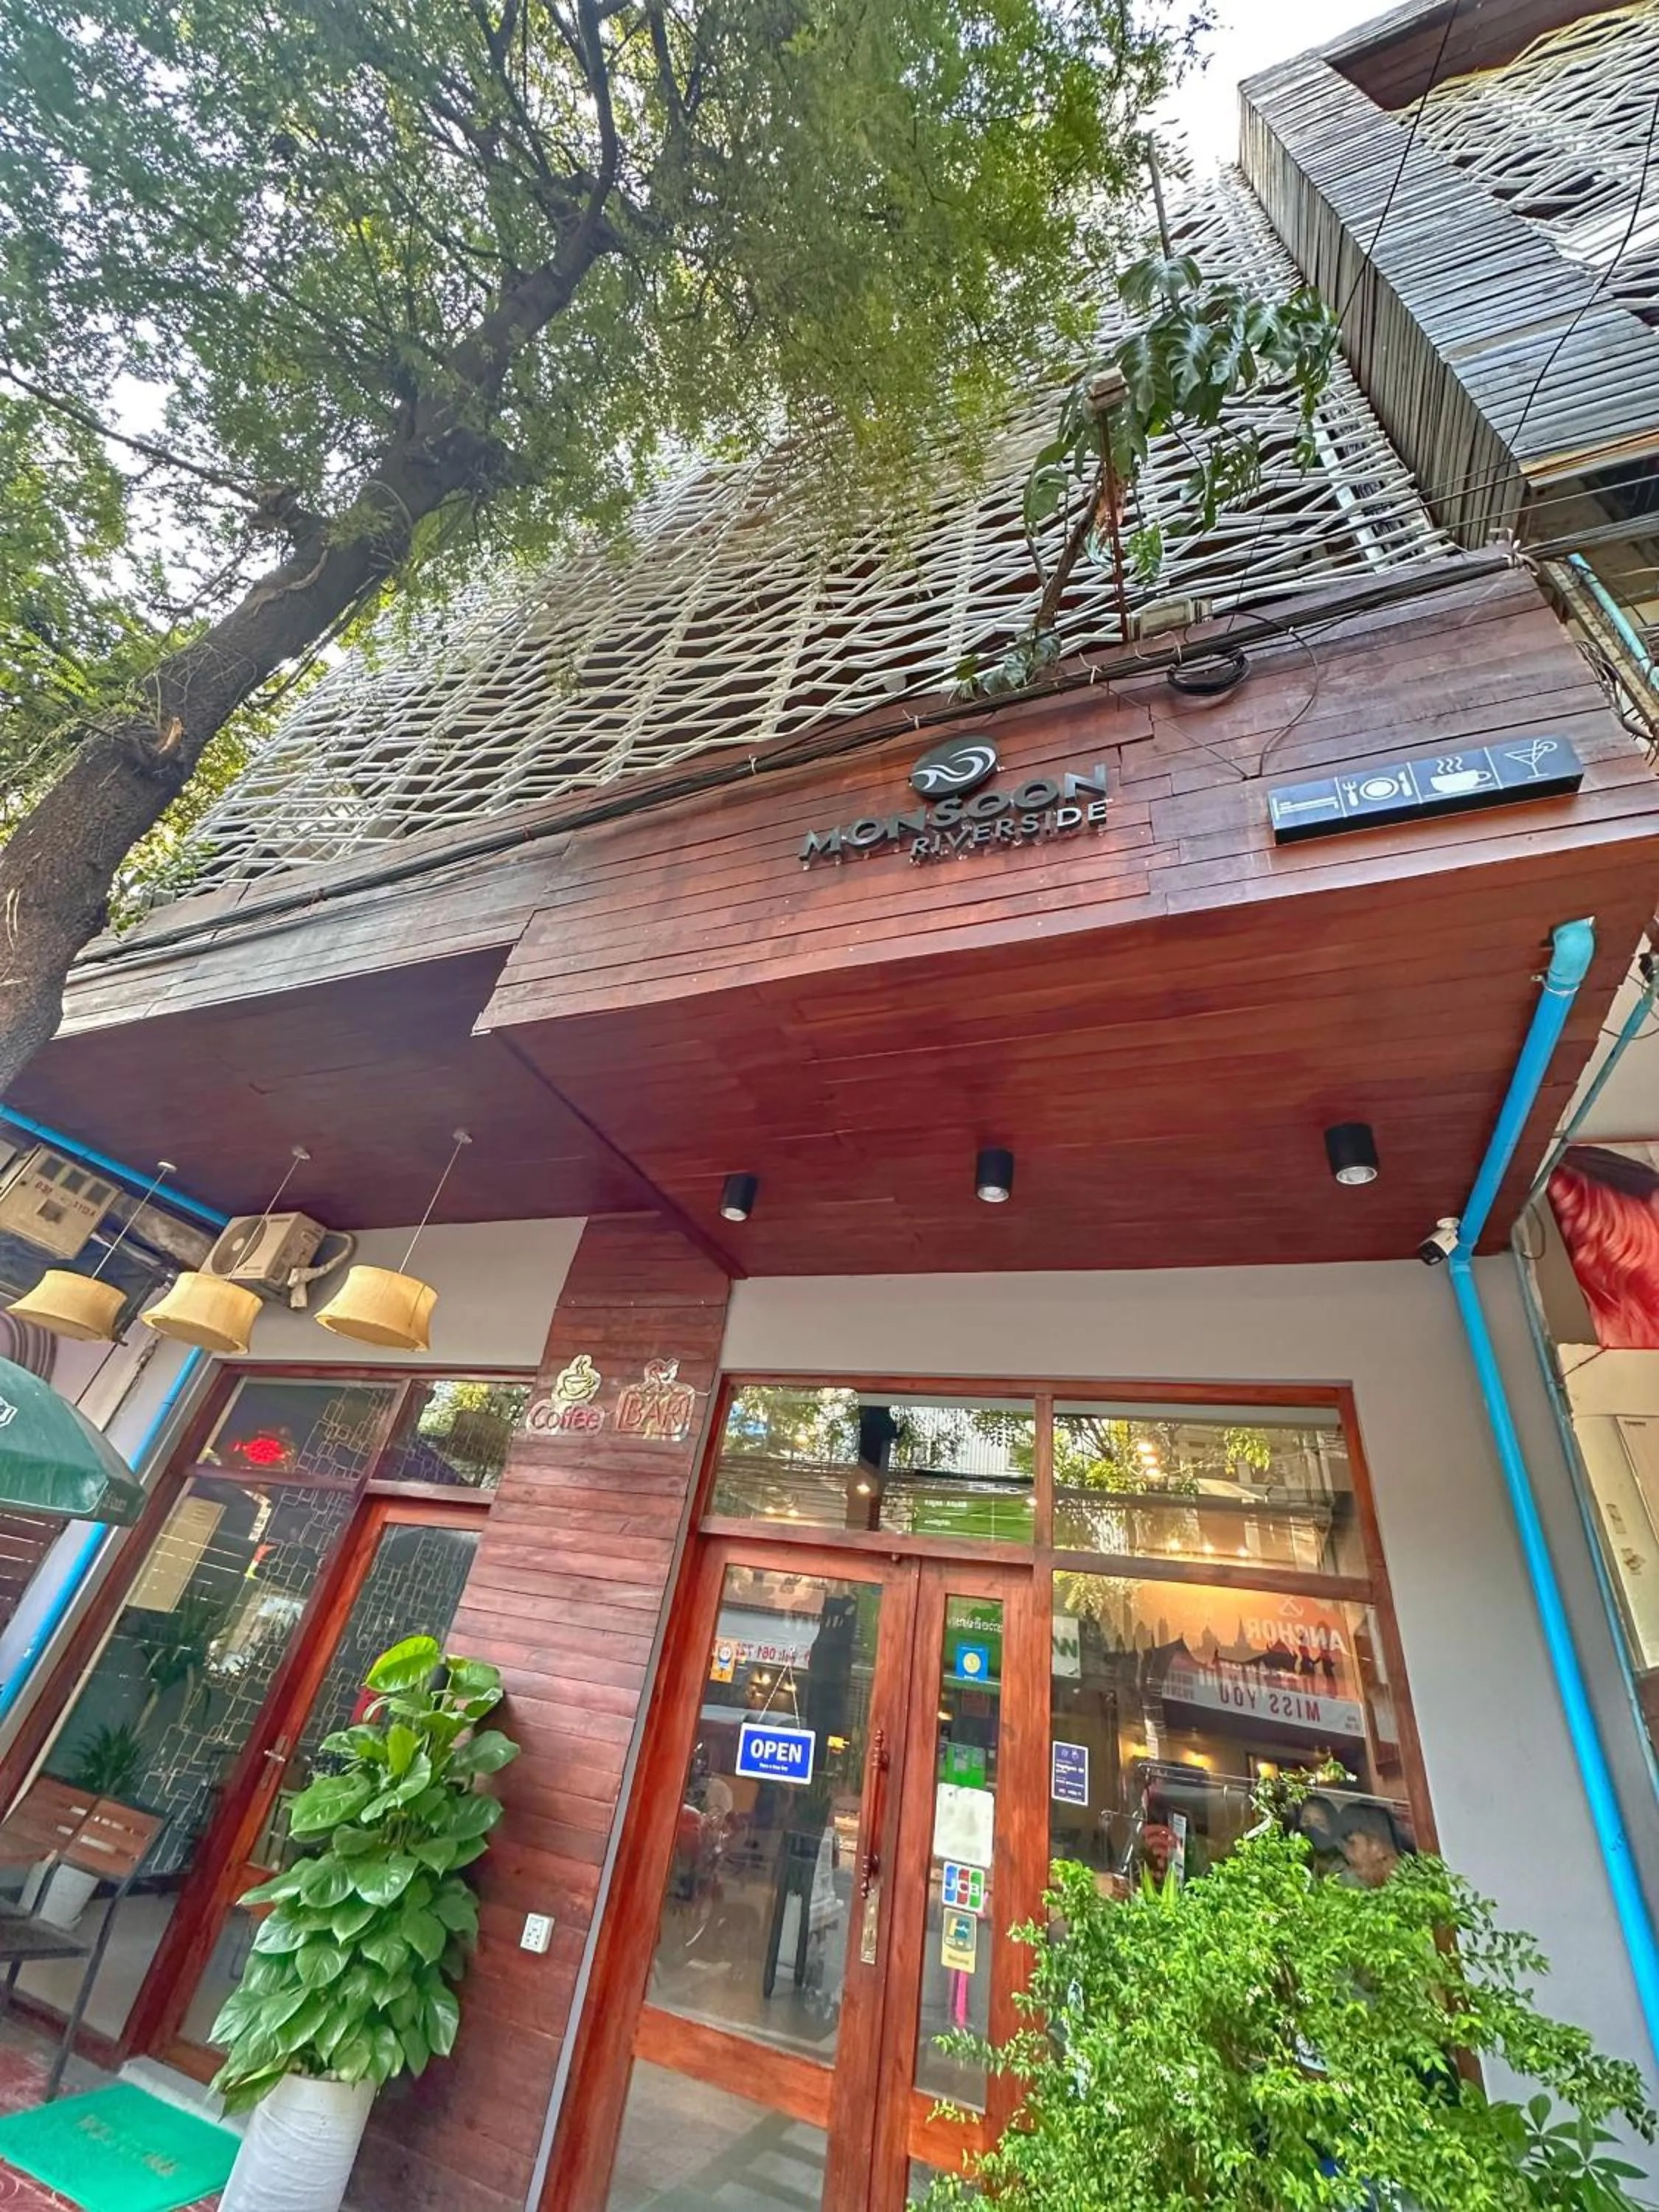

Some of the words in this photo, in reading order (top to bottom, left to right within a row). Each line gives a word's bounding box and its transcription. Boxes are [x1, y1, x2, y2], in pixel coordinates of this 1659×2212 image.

[799, 762, 1107, 861] MONSOON
[910, 800, 1107, 857] RIVERSIDE
[532, 1405, 599, 1430] Coffee
[626, 1394, 684, 1427] BAR
[750, 1738, 803, 1764] OPEN
